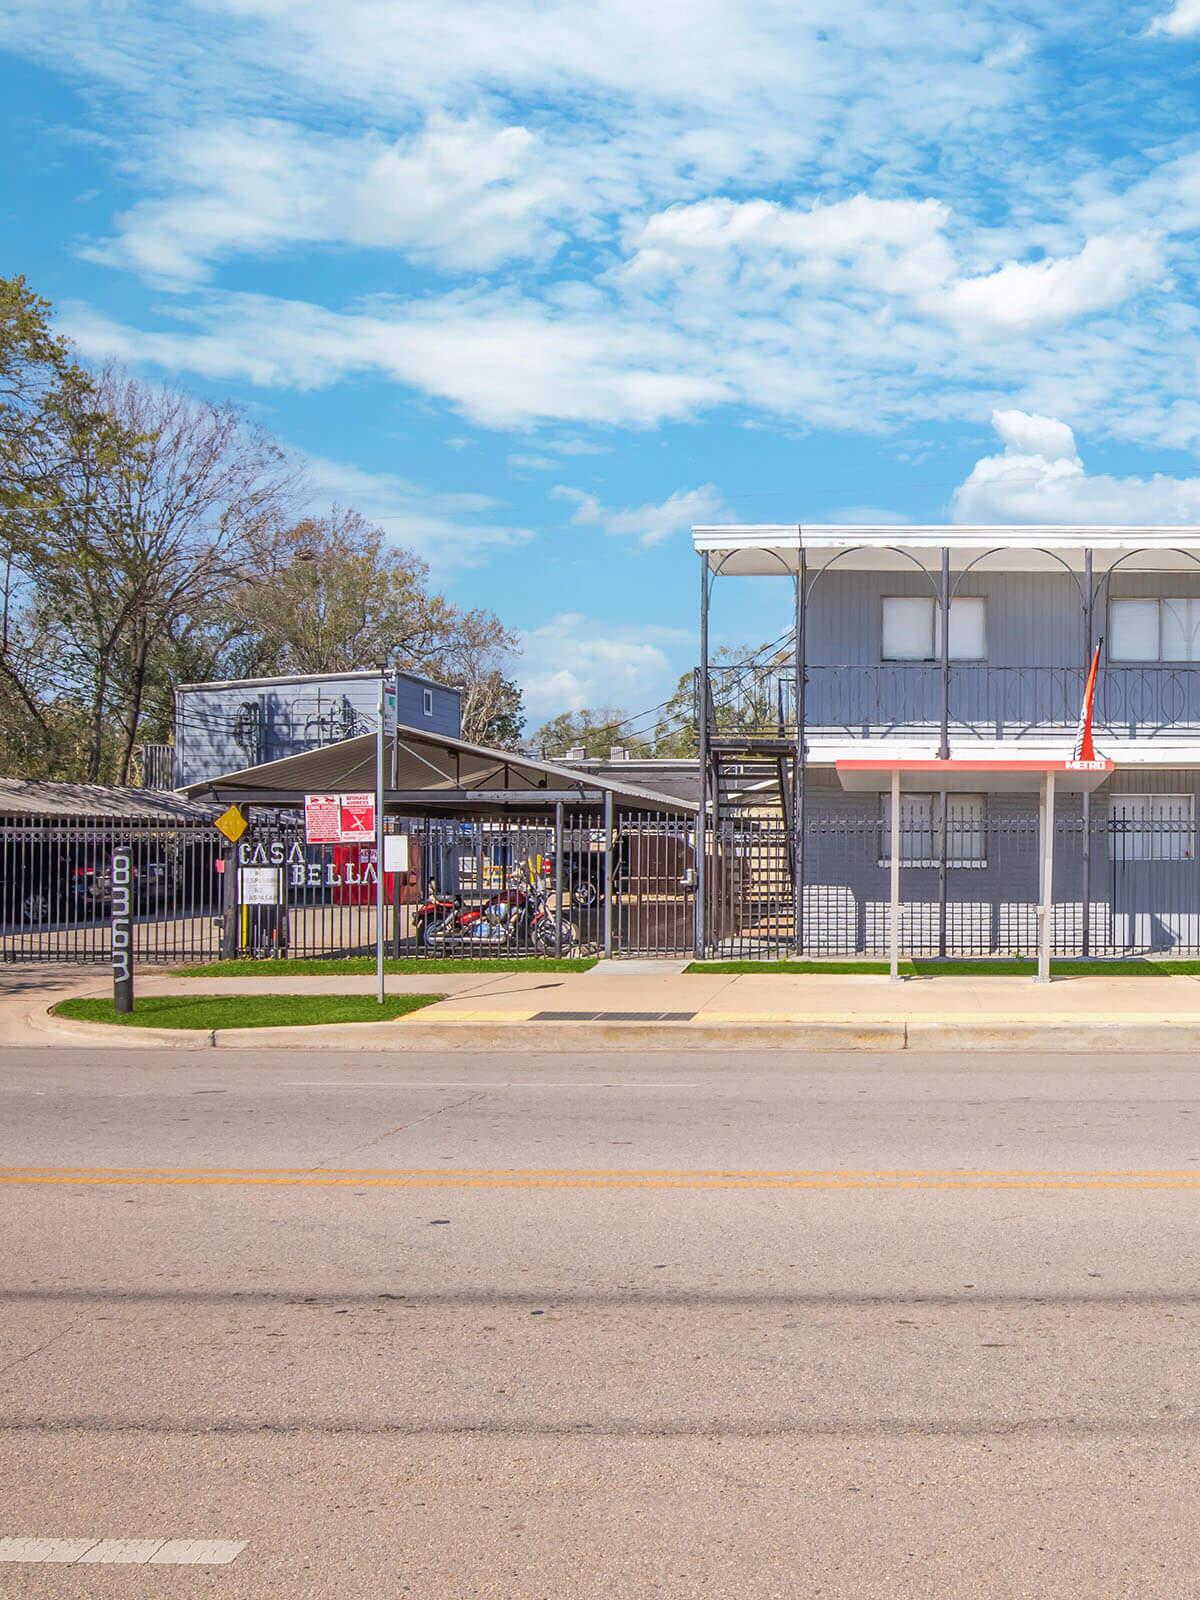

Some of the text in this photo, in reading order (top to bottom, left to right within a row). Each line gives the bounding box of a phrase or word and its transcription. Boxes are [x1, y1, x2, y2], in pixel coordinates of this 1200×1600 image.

[1065, 760, 1106, 770] METRO
[239, 841, 306, 865] CASA
[290, 863, 378, 886] BELLA
